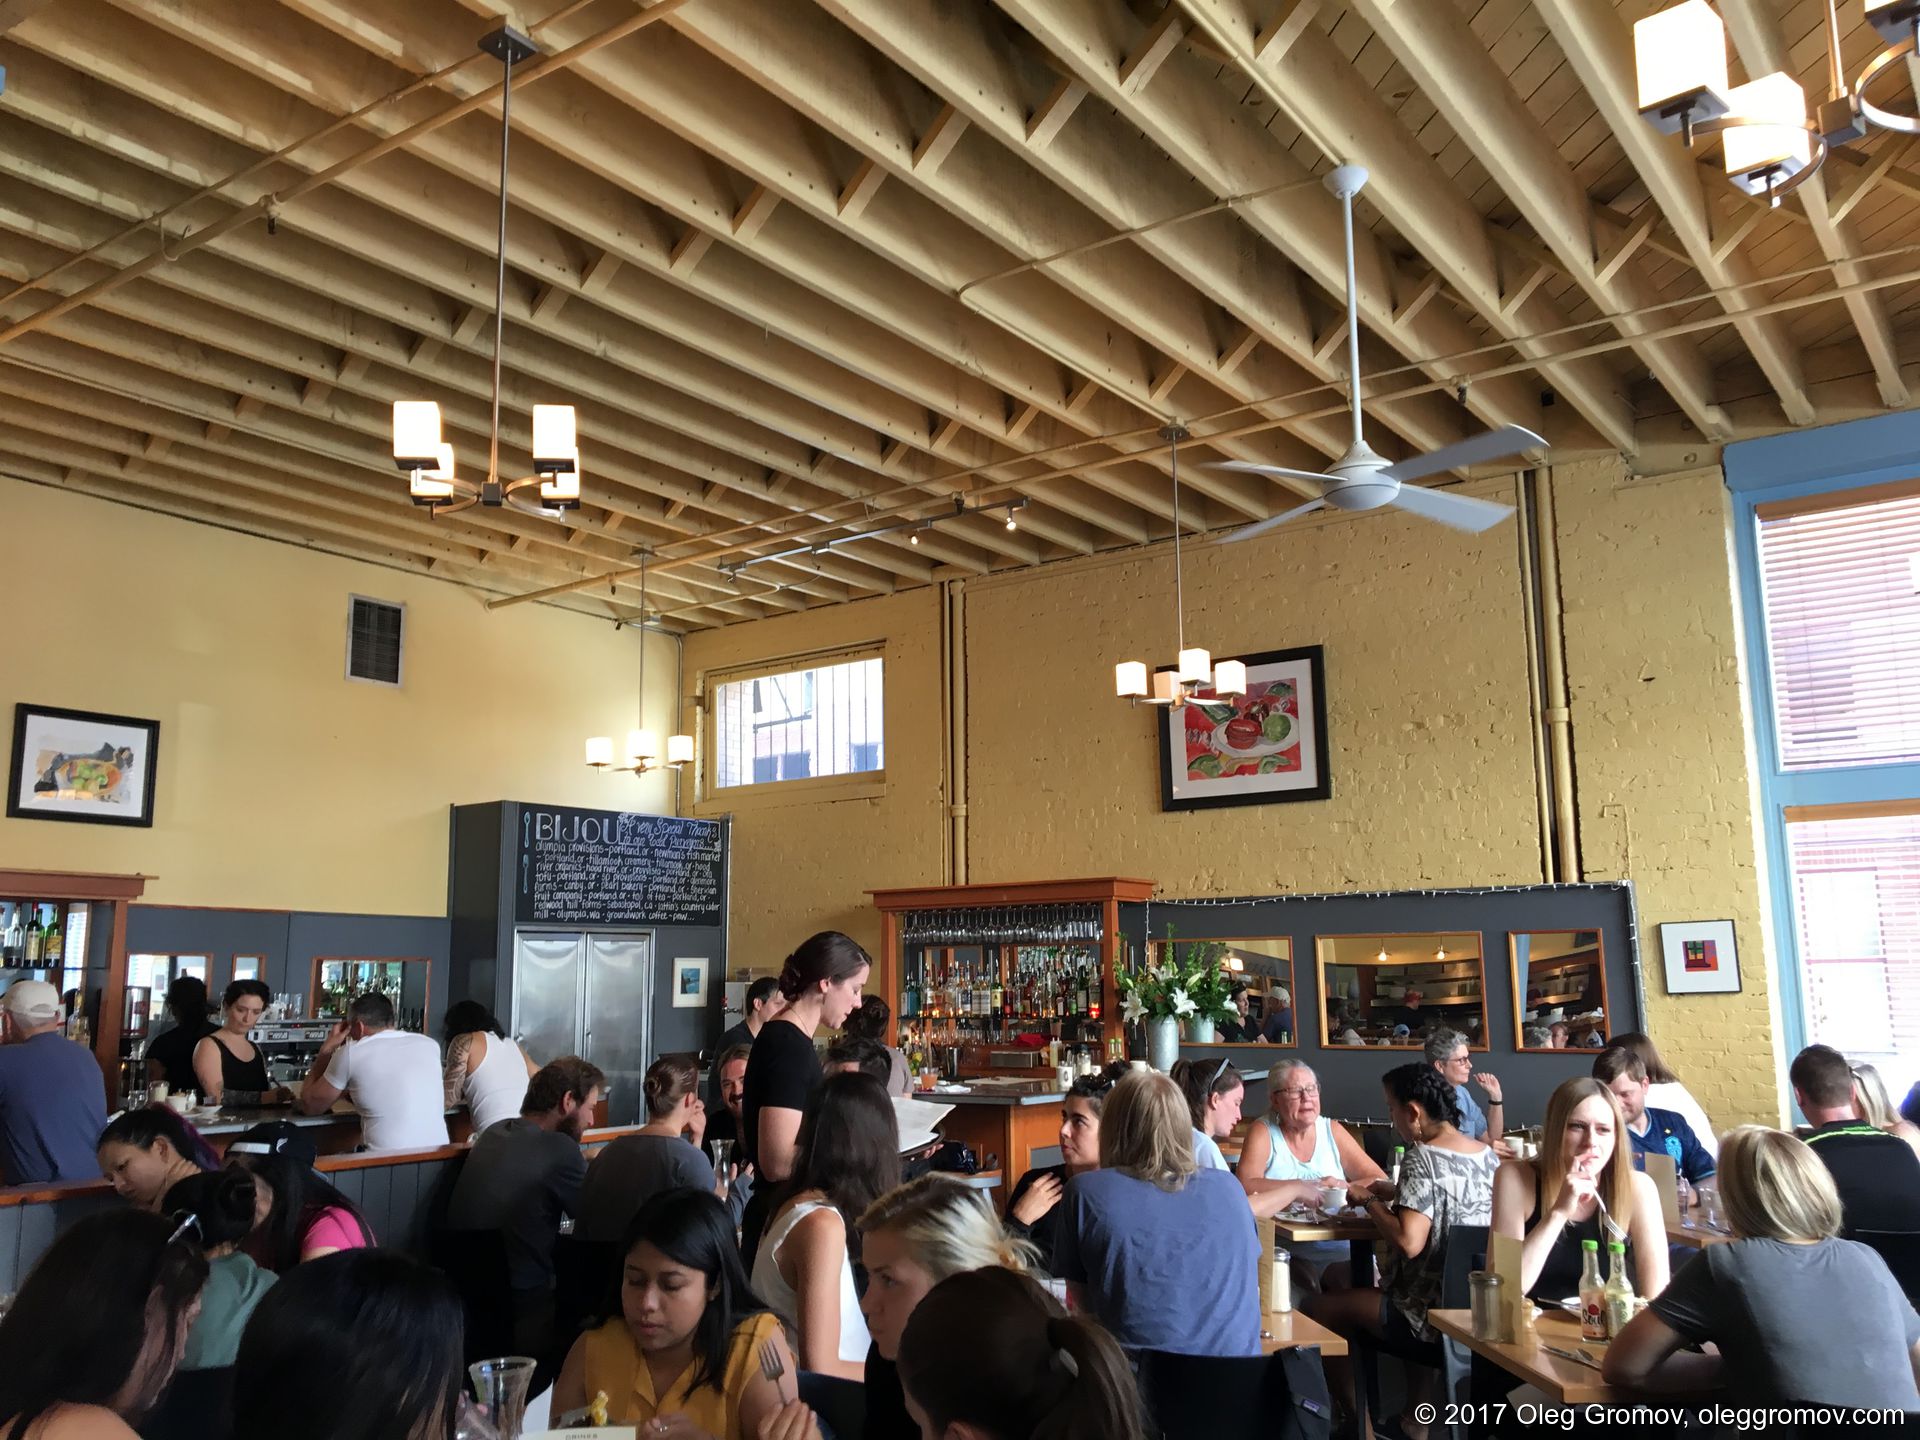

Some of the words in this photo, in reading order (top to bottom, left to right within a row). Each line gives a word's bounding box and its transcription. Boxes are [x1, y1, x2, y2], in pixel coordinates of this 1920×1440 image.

[536, 813, 619, 844] BIJOU
[654, 817, 684, 840] Special
[687, 820, 717, 843] Thanks
[701, 852, 720, 862] market
[535, 900, 563, 910] redwood
[567, 900, 578, 910] hill
[534, 909, 549, 919] mill
[604, 909, 646, 922] groundwork
